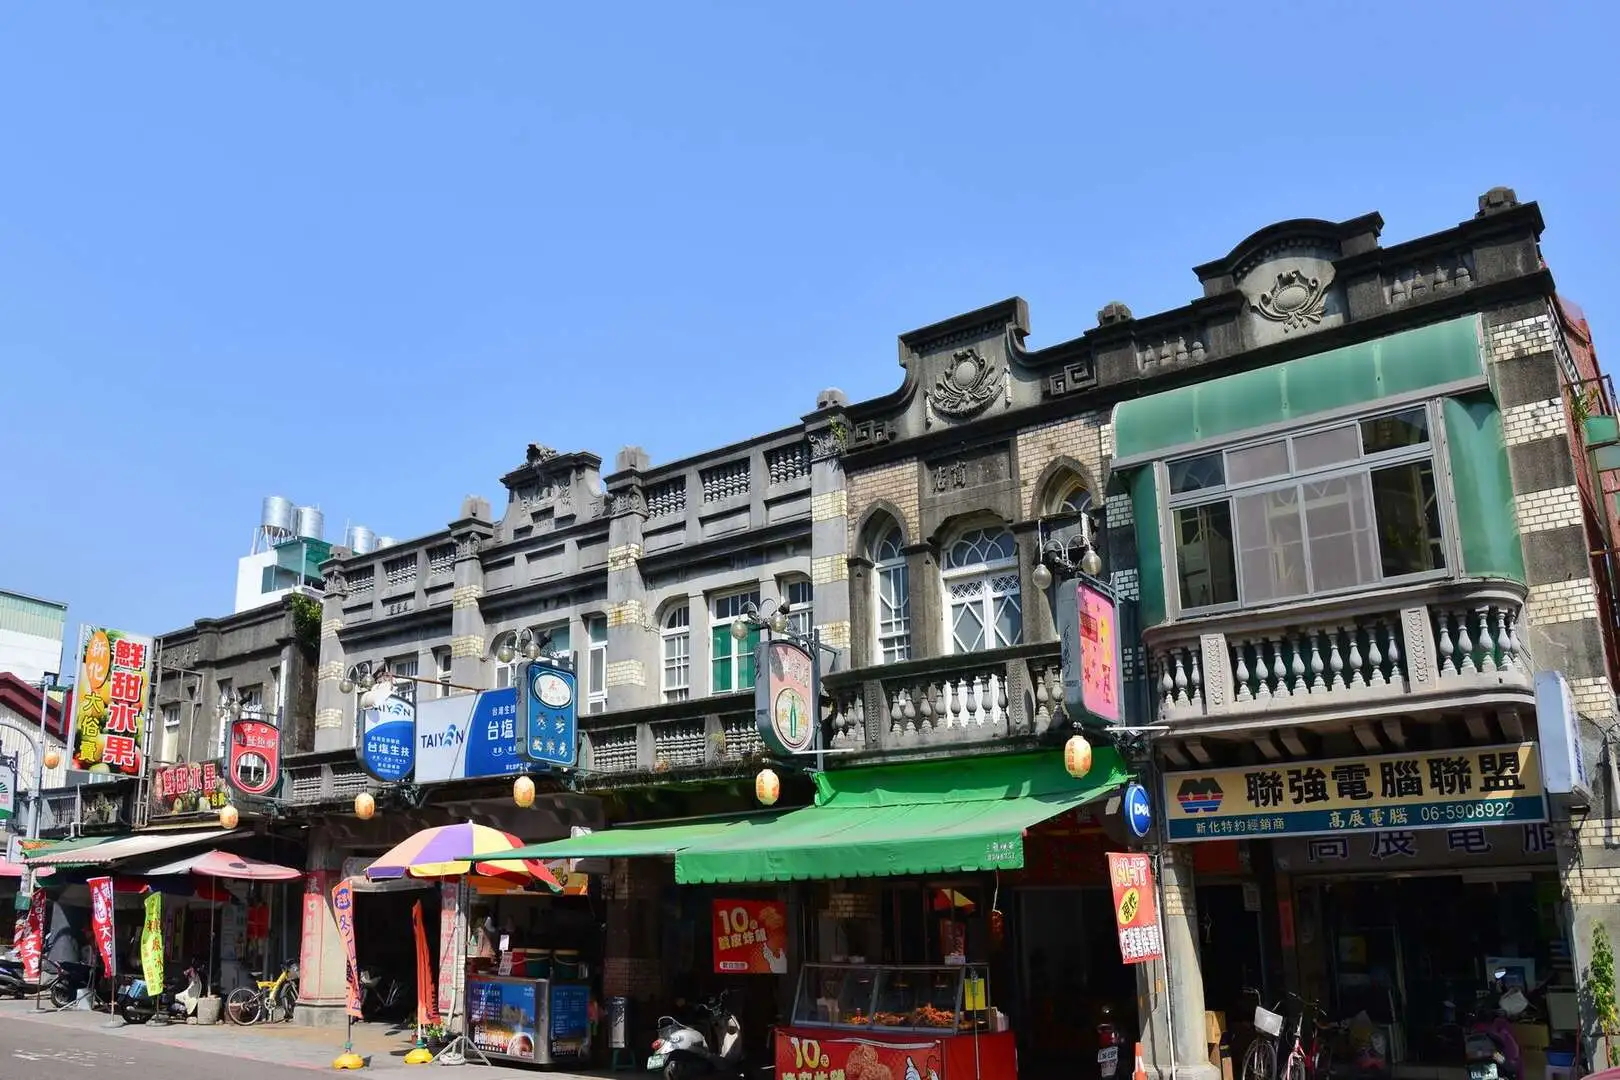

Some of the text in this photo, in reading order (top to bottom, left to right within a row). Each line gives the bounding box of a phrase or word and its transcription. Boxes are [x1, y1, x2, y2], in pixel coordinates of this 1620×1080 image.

[87, 640, 108, 683] 新化
[78, 692, 102, 763] 大俗賣
[102, 639, 147, 767] 鮮甜水果
[1244, 751, 1526, 808] 聯強電腦聯盟
[1195, 818, 1285, 835] 新化特約經銷商
[1420, 802, 1515, 822] 06-5908922
